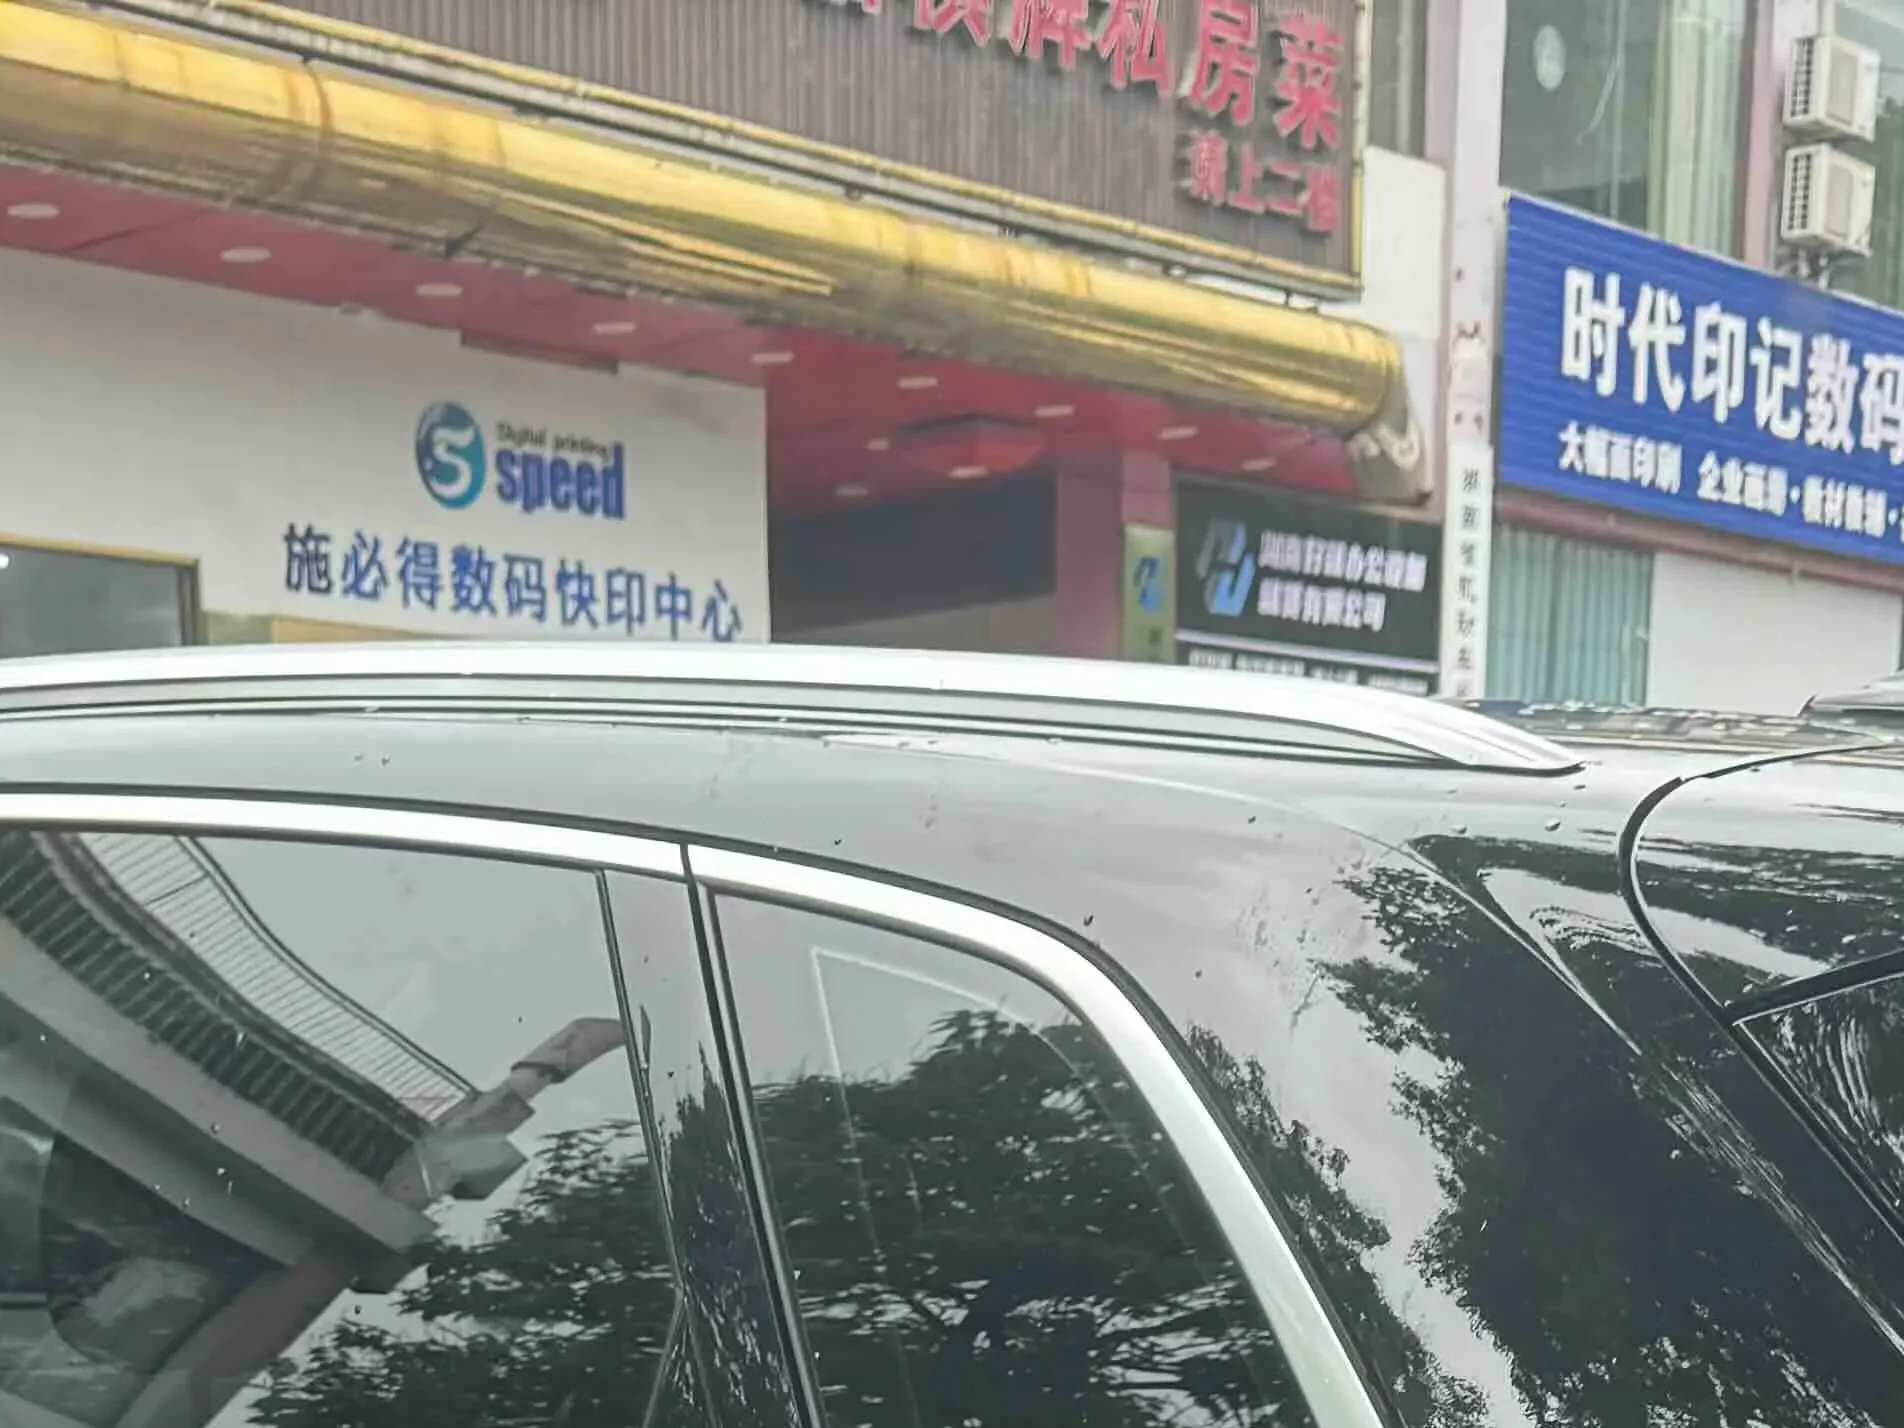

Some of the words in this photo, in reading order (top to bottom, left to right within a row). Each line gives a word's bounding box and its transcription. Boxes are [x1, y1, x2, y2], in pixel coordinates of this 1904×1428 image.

[283, 522, 743, 644] 施必得数码快印中心
